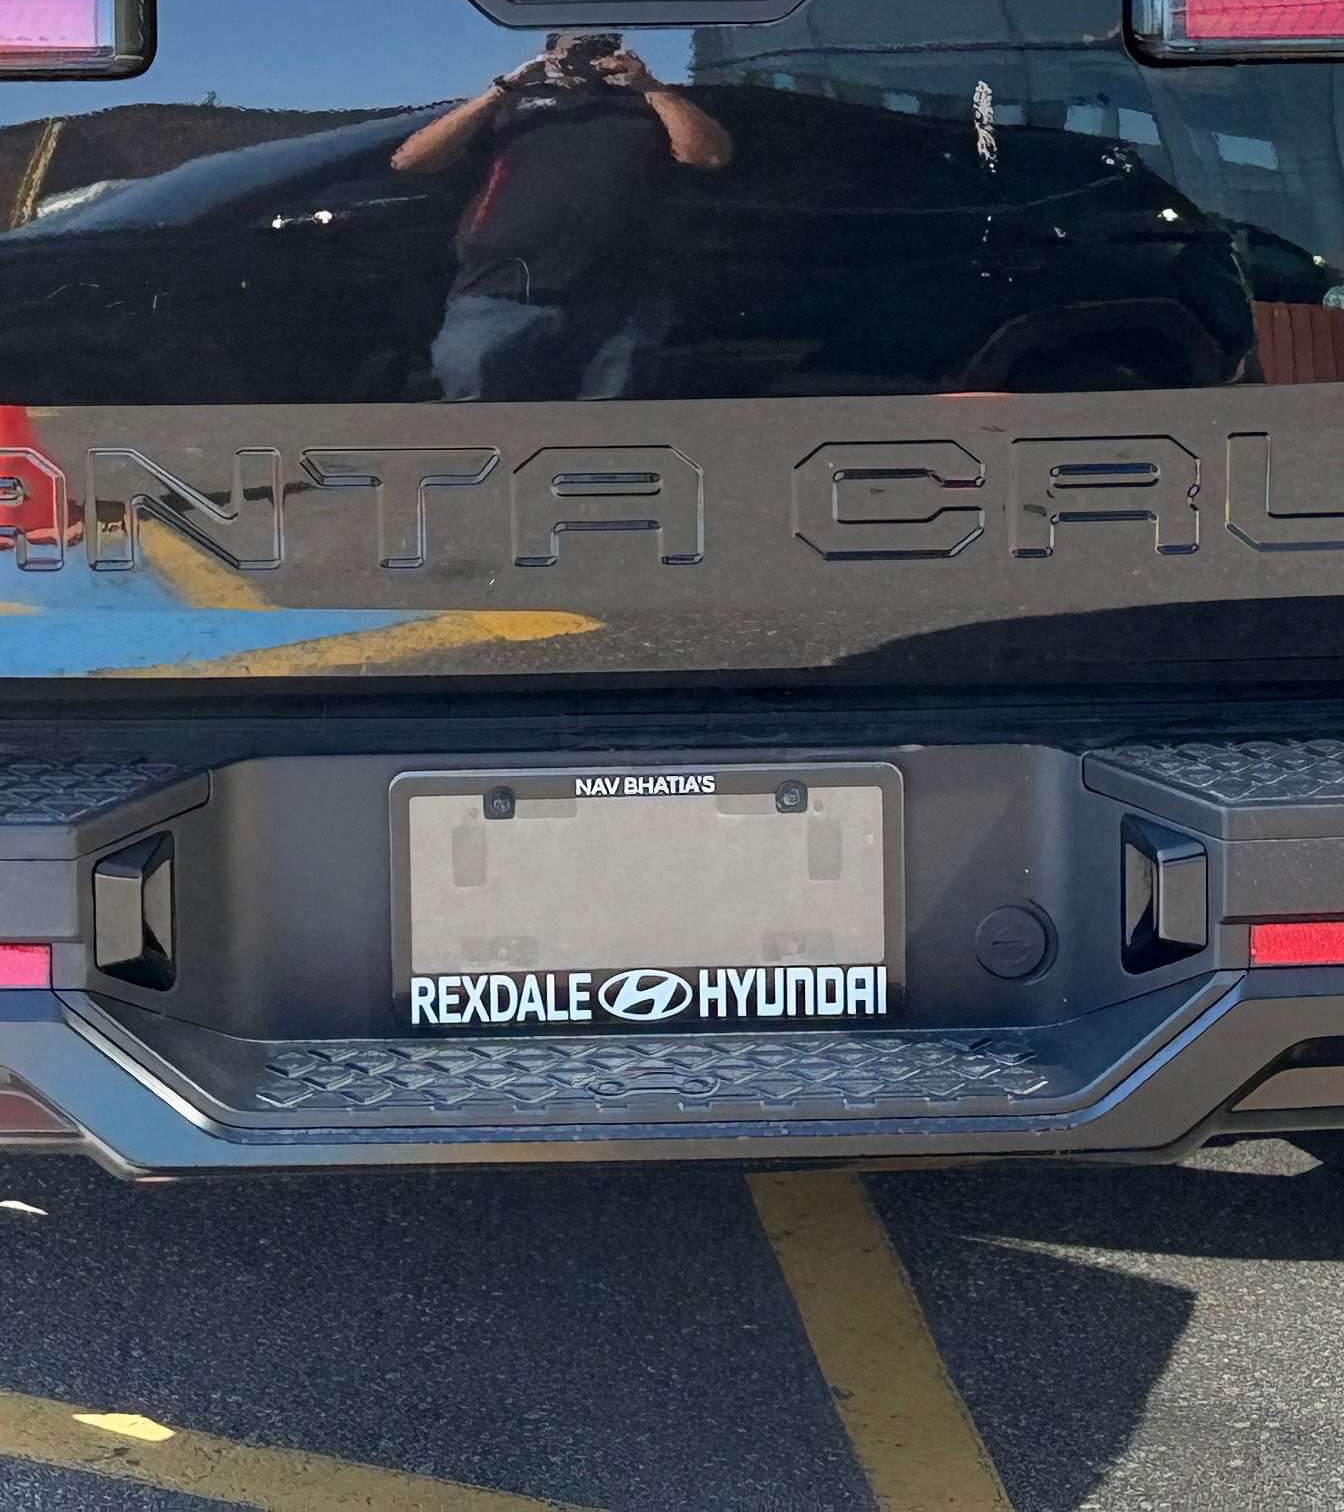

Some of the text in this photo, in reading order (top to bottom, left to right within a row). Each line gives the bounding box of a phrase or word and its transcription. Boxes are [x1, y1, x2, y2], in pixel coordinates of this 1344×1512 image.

[574, 774, 716, 796] NAV BHATIA'S
[410, 965, 888, 1025] REXDALE HYUNDAI
